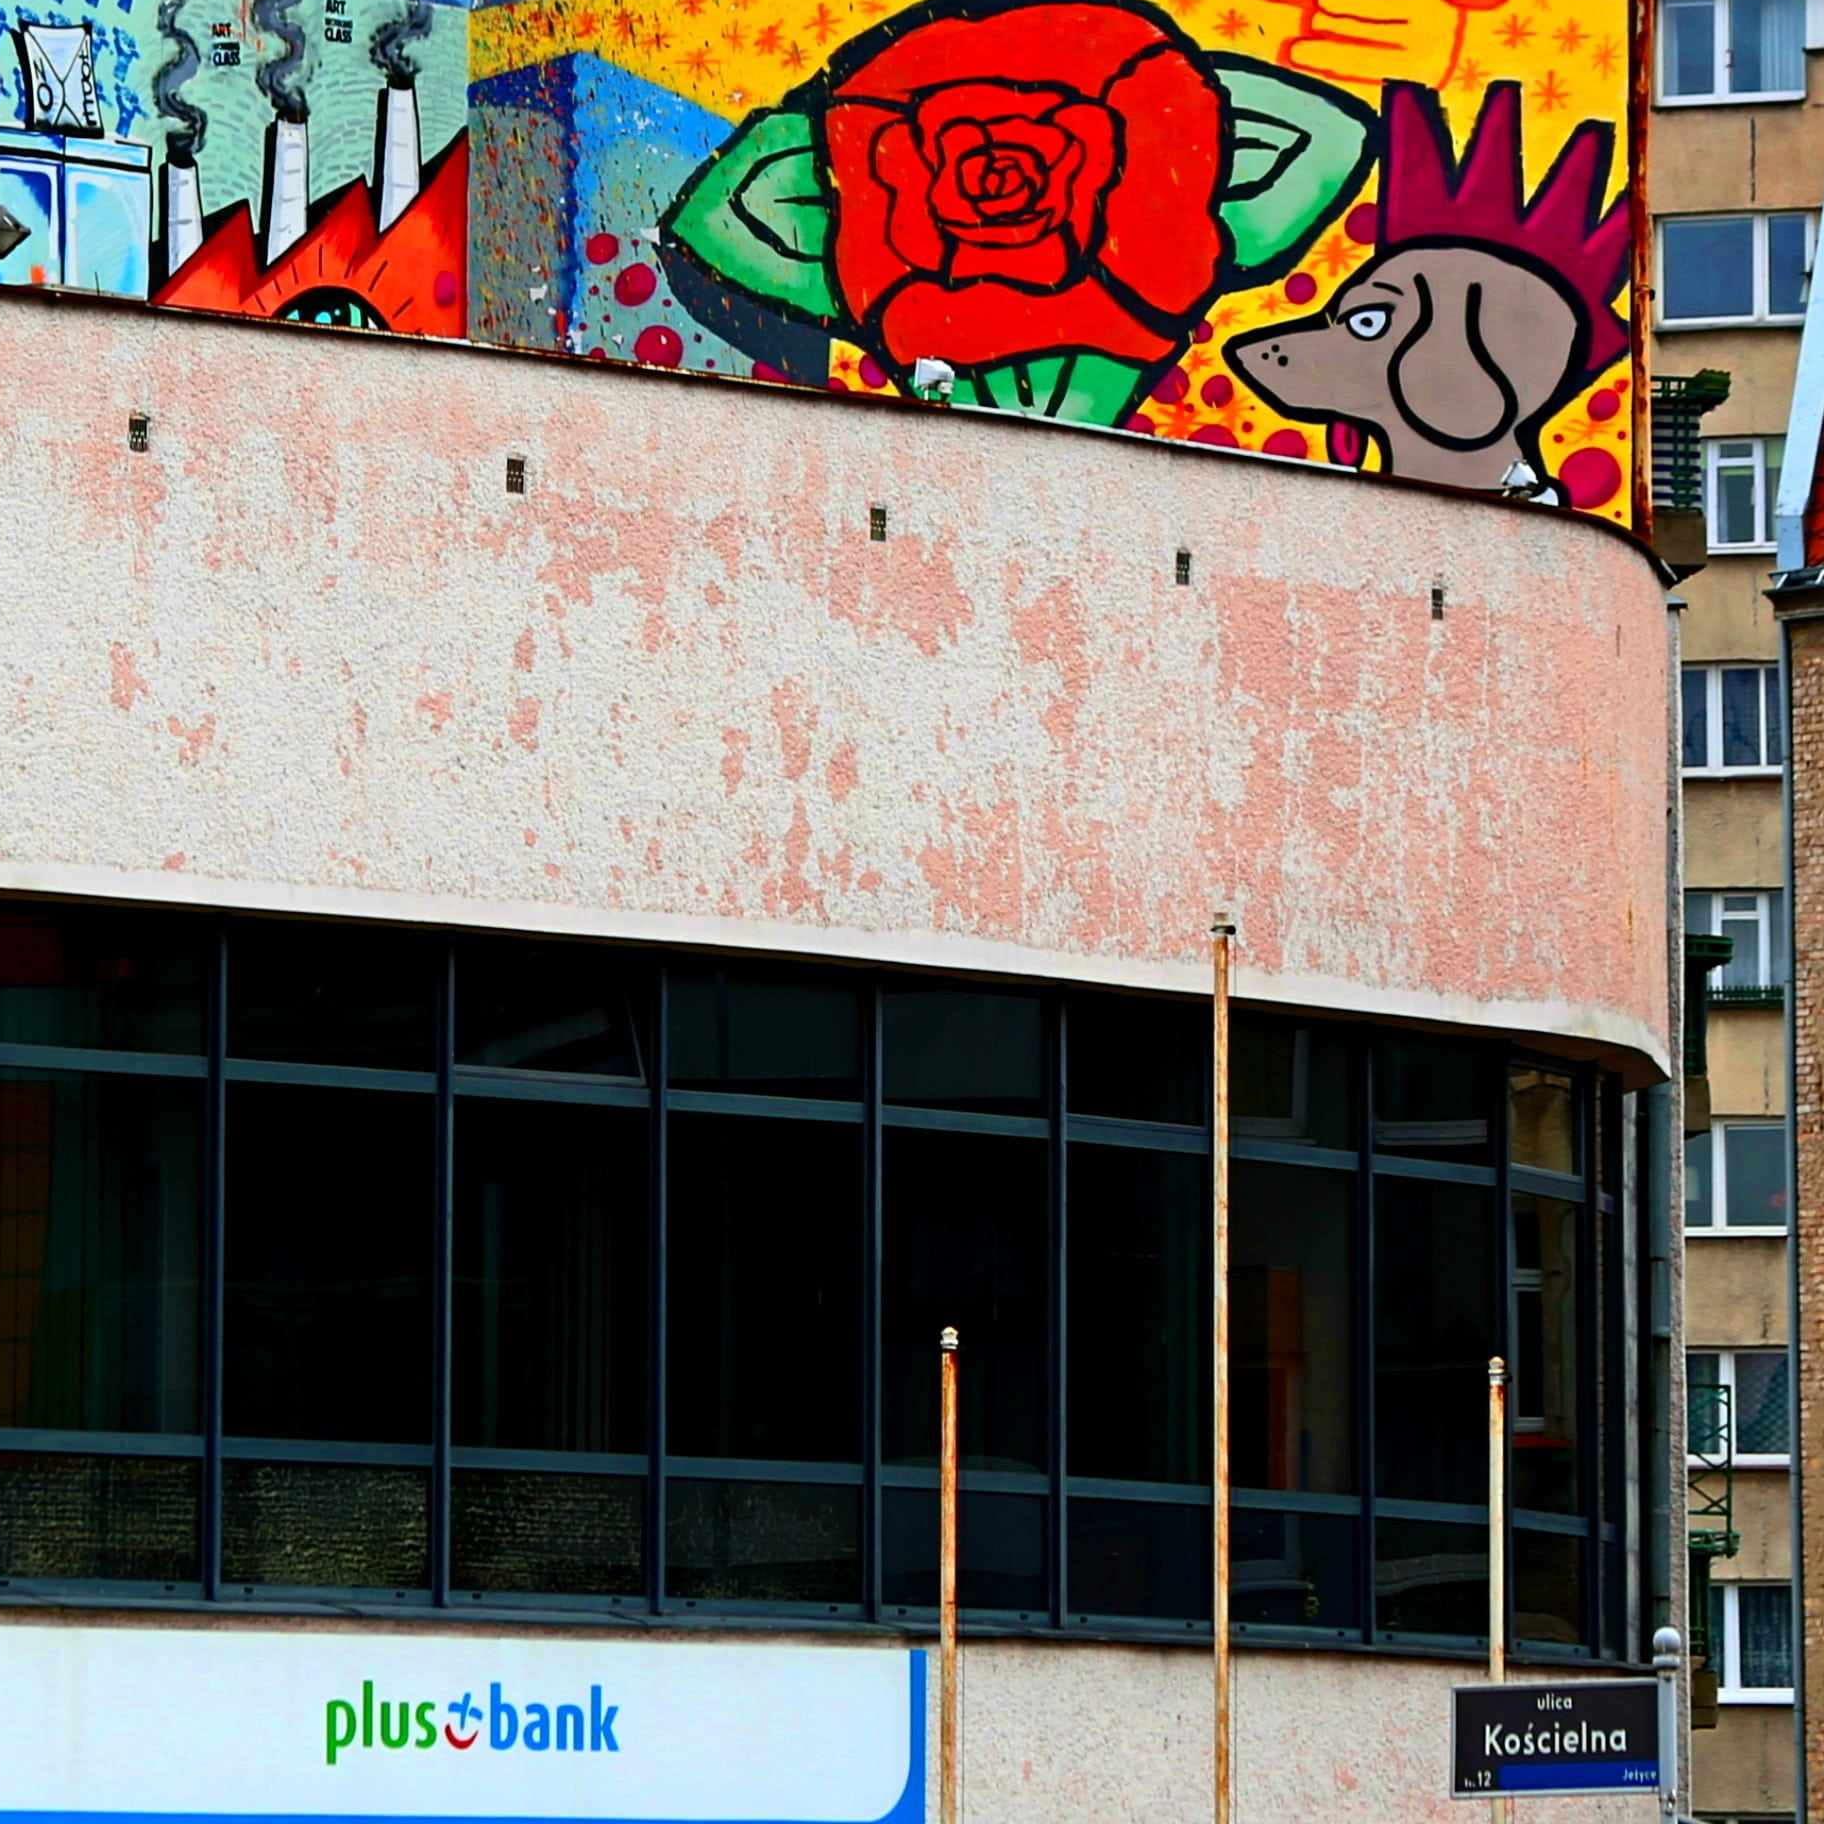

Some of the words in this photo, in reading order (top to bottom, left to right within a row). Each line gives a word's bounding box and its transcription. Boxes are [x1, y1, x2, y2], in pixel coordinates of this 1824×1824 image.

[211, 23, 232, 38] ART
[325, 28, 353, 44] CLASS
[212, 51, 241, 67] CLASS
[1536, 1693, 1573, 1710] ulica
[326, 1680, 438, 1766] plus
[489, 1682, 620, 1752] bank
[1484, 1720, 1627, 1757] Kościelna
[1477, 1769, 1492, 1787] 12
